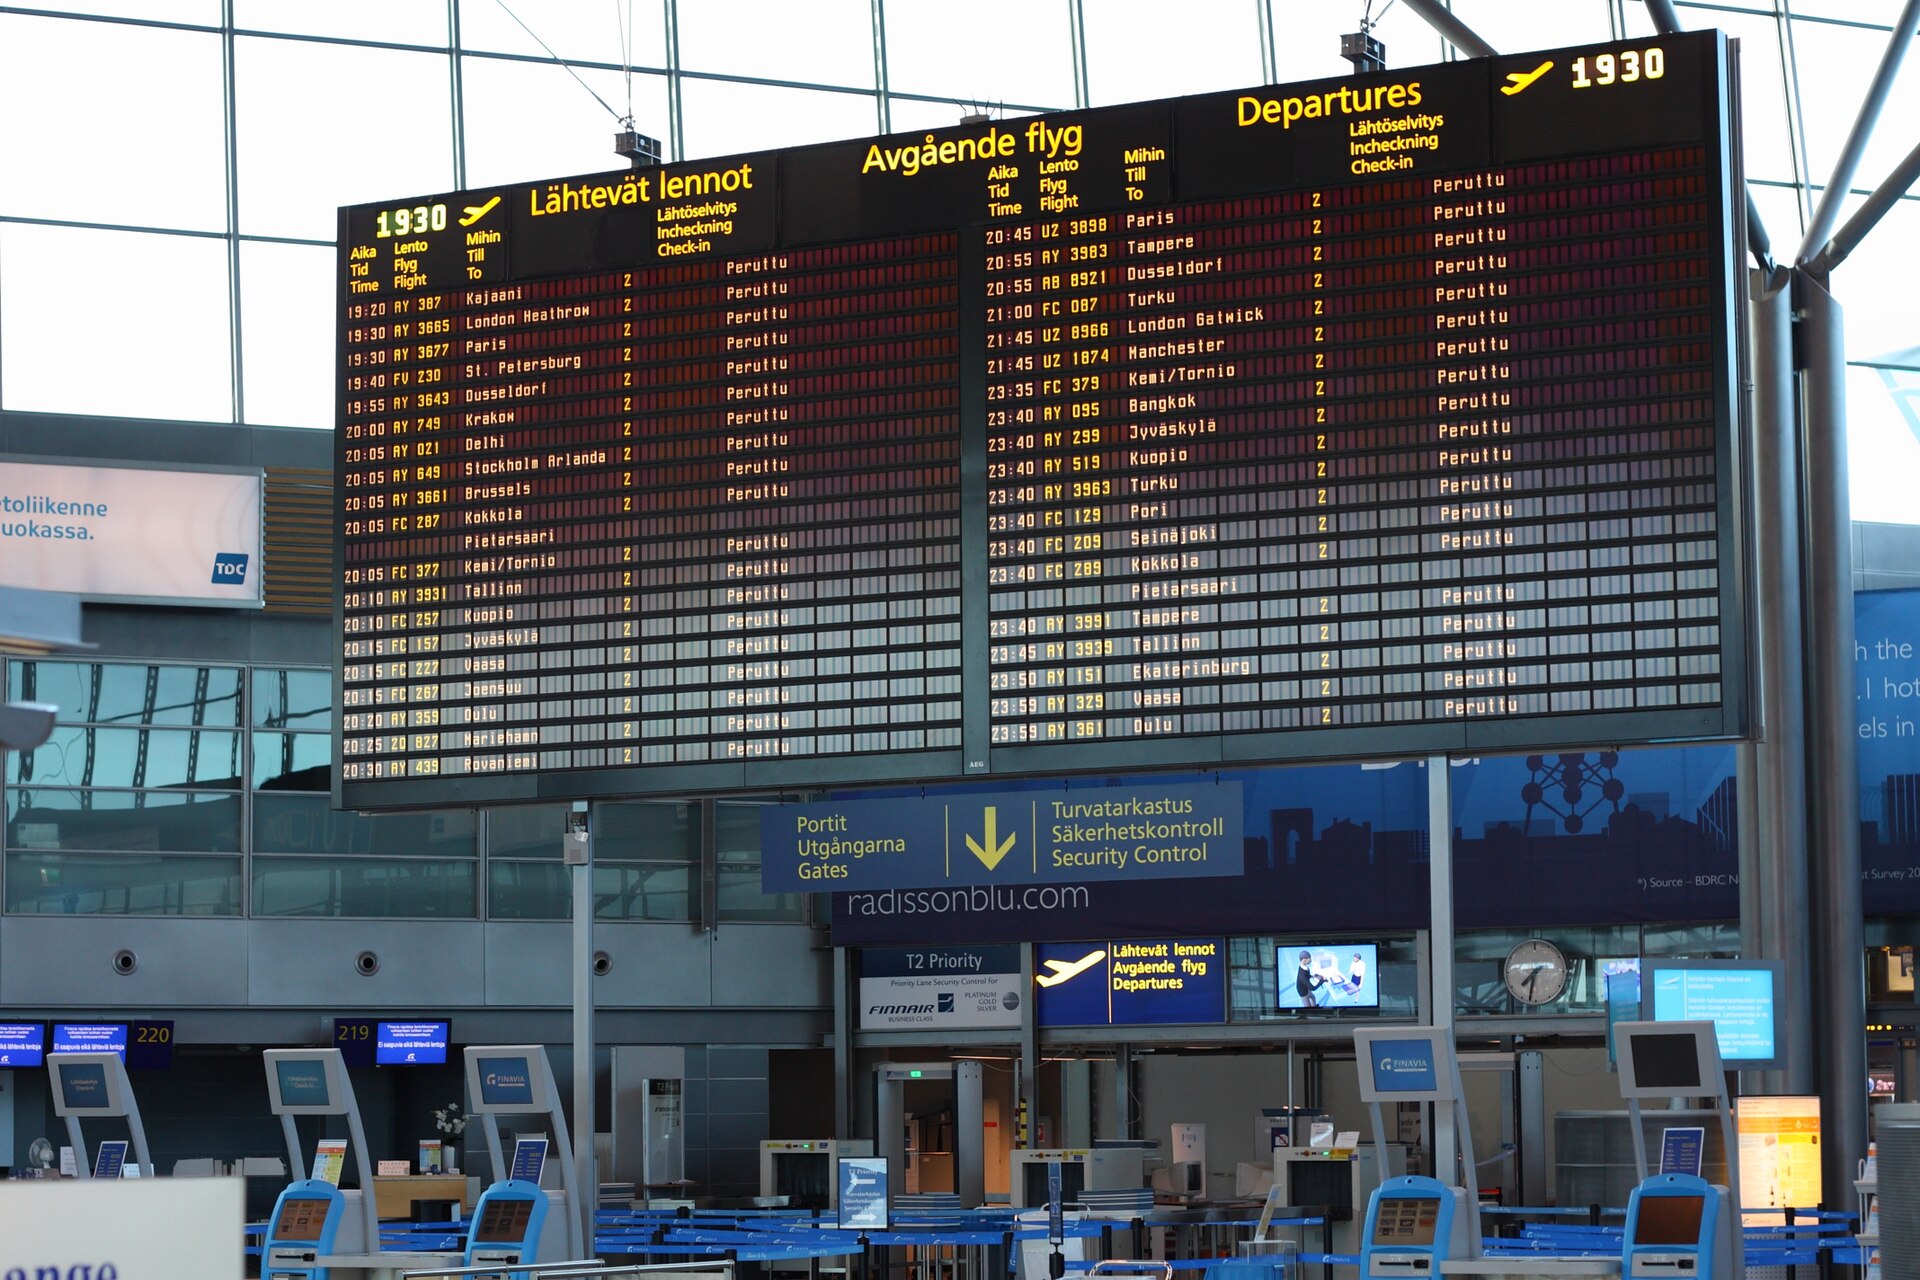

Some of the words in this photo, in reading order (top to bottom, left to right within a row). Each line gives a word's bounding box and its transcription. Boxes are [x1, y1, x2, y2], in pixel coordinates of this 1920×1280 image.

[1572, 48, 1663, 88] 1930
[1238, 82, 1422, 128] Departures
[1350, 114, 1443, 136] Lähtöselvitys
[862, 128, 1017, 176] Avgående
[1025, 121, 1082, 158] flyg
[1351, 134, 1438, 155] Incheckning
[1125, 148, 1164, 163] Mihin
[988, 165, 1018, 180] Aika
[1040, 159, 1078, 174] Lento
[1351, 155, 1413, 174] Check-in
[1125, 166, 1145, 182] Till
[531, 176, 650, 216] Lähtevät
[660, 164, 752, 199] lennot
[988, 183, 1009, 198] Tid
[1040, 178, 1067, 194] Flyg
[1126, 187, 1143, 200] To
[986, 226, 1031, 245] 20:45
[1041, 223, 1059, 239] U2
[1070, 217, 1107, 235] 3898
[1126, 211, 1174, 228] Paris
[1312, 192, 1321, 208] 2
[1433, 173, 1504, 193] Peruttu
[988, 203, 1022, 216] Time
[1041, 194, 1078, 212] Flight
[658, 202, 737, 222] Lähtöselvitys
[467, 230, 500, 245] Mihin
[658, 220, 732, 239] Incheckning
[986, 252, 1032, 271] 20:55
[1042, 249, 1060, 264] AY
[1070, 243, 1108, 261] 3983
[1127, 236, 1194, 254] Tampere
[1313, 219, 1322, 234] 2
[1434, 200, 1505, 221] Peruttu
[351, 246, 376, 259] Aika
[395, 241, 428, 254] Lento
[467, 248, 484, 262] Till
[658, 239, 710, 256] Check-in
[351, 262, 368, 276] Tid
[394, 258, 417, 273] Flyg
[467, 267, 482, 279] To
[1127, 257, 1222, 281] Dusseldorf
[348, 302, 386, 319] 19:20
[394, 299, 410, 313] AY
[418, 295, 442, 311] 387
[466, 286, 522, 306] Kajaani
[623, 273, 632, 287] 2
[727, 256, 787, 275] Peruttu
[351, 281, 379, 293] Time
[394, 273, 426, 290] Flight
[1128, 290, 1175, 307] Turku
[348, 326, 386, 342] 19:30
[393, 323, 409, 338] AY
[418, 319, 450, 335] 3665
[466, 313, 515, 330] London
[523, 305, 590, 323] Heathrow
[623, 298, 632, 312] 2
[727, 281, 787, 300] Peruttu
[1128, 316, 1185, 334] London
[1196, 307, 1264, 327] Gatwick
[466, 338, 506, 353] Paris
[1128, 339, 1225, 360] Manchester
[466, 364, 488, 378] St.
[498, 356, 581, 374] Petersburg
[1129, 365, 1235, 386] Kemi/Tornio
[466, 382, 546, 402] Dusseldorf
[1129, 393, 1196, 413] Bangkok
[465, 411, 514, 426] Krakow
[1130, 418, 1216, 441] Jyväskylä
[465, 435, 504, 451] Delhi
[465, 457, 539, 476] Stockholm
[548, 450, 606, 467] Arlanda
[1130, 448, 1187, 465] Kuopio
[465, 482, 530, 500] Brussels
[1130, 476, 1178, 492] Turku
[0, 496, 107, 516] toliikenne
[1131, 503, 1167, 519] Pori
[465, 508, 522, 524] Kokkola
[465, 531, 554, 549] Pietarsaari
[1131, 526, 1216, 545] Seinäjoki
[216, 563, 244, 576] TDC
[464, 556, 555, 573] Kemi/Tornio
[1131, 554, 1199, 572] Kokkola
[465, 582, 522, 598] Tallinn
[1132, 581, 1236, 598] Pietarsaari
[464, 609, 513, 623] Kuopio
[1133, 610, 1199, 626] Tampere
[465, 628, 538, 649] Jyväskylä
[1133, 636, 1200, 652] Tallinn
[1875, 638, 1912, 660] the
[464, 659, 505, 672] Vaasa
[1133, 661, 1249, 679] Ekaterinburg
[465, 683, 521, 696] Joensuu
[1134, 692, 1181, 706] Vaasa
[464, 707, 497, 721] Oulu
[1134, 718, 1172, 733] Oulu
[1896, 714, 1914, 736] in
[464, 731, 538, 745] Mariehamn
[464, 757, 536, 771] Rovaniemi
[1052, 798, 1192, 819] Turvatarkastus
[797, 815, 847, 833] Portit
[1052, 817, 1223, 844] Säkerhetskontroll
[798, 836, 905, 860] Utgångarna
[1053, 847, 1127, 869] Security
[1135, 843, 1207, 865] Control
[799, 862, 848, 880] Gates
[1872, 868, 1905, 880] Survey
[1650, 877, 1682, 888] Source
[1695, 875, 1726, 886] BDRC
[848, 885, 1088, 915] radissonblu.com
[1114, 945, 1167, 957] Lähtevät
[1175, 943, 1214, 955] lennot
[906, 954, 924, 969] T2
[930, 953, 982, 971] Priority
[1114, 960, 1175, 976] Avgående
[1182, 959, 1205, 975] flyg
[891, 980, 914, 988] Priority
[934, 980, 960, 988] Security
[961, 978, 986, 986] Control
[1114, 978, 1182, 992] Departures
[869, 1004, 934, 1014] FINNAIR
[137, 1027, 169, 1043] 220
[338, 1026, 369, 1040] 219
[1394, 1060, 1427, 1068] FINAVIA
